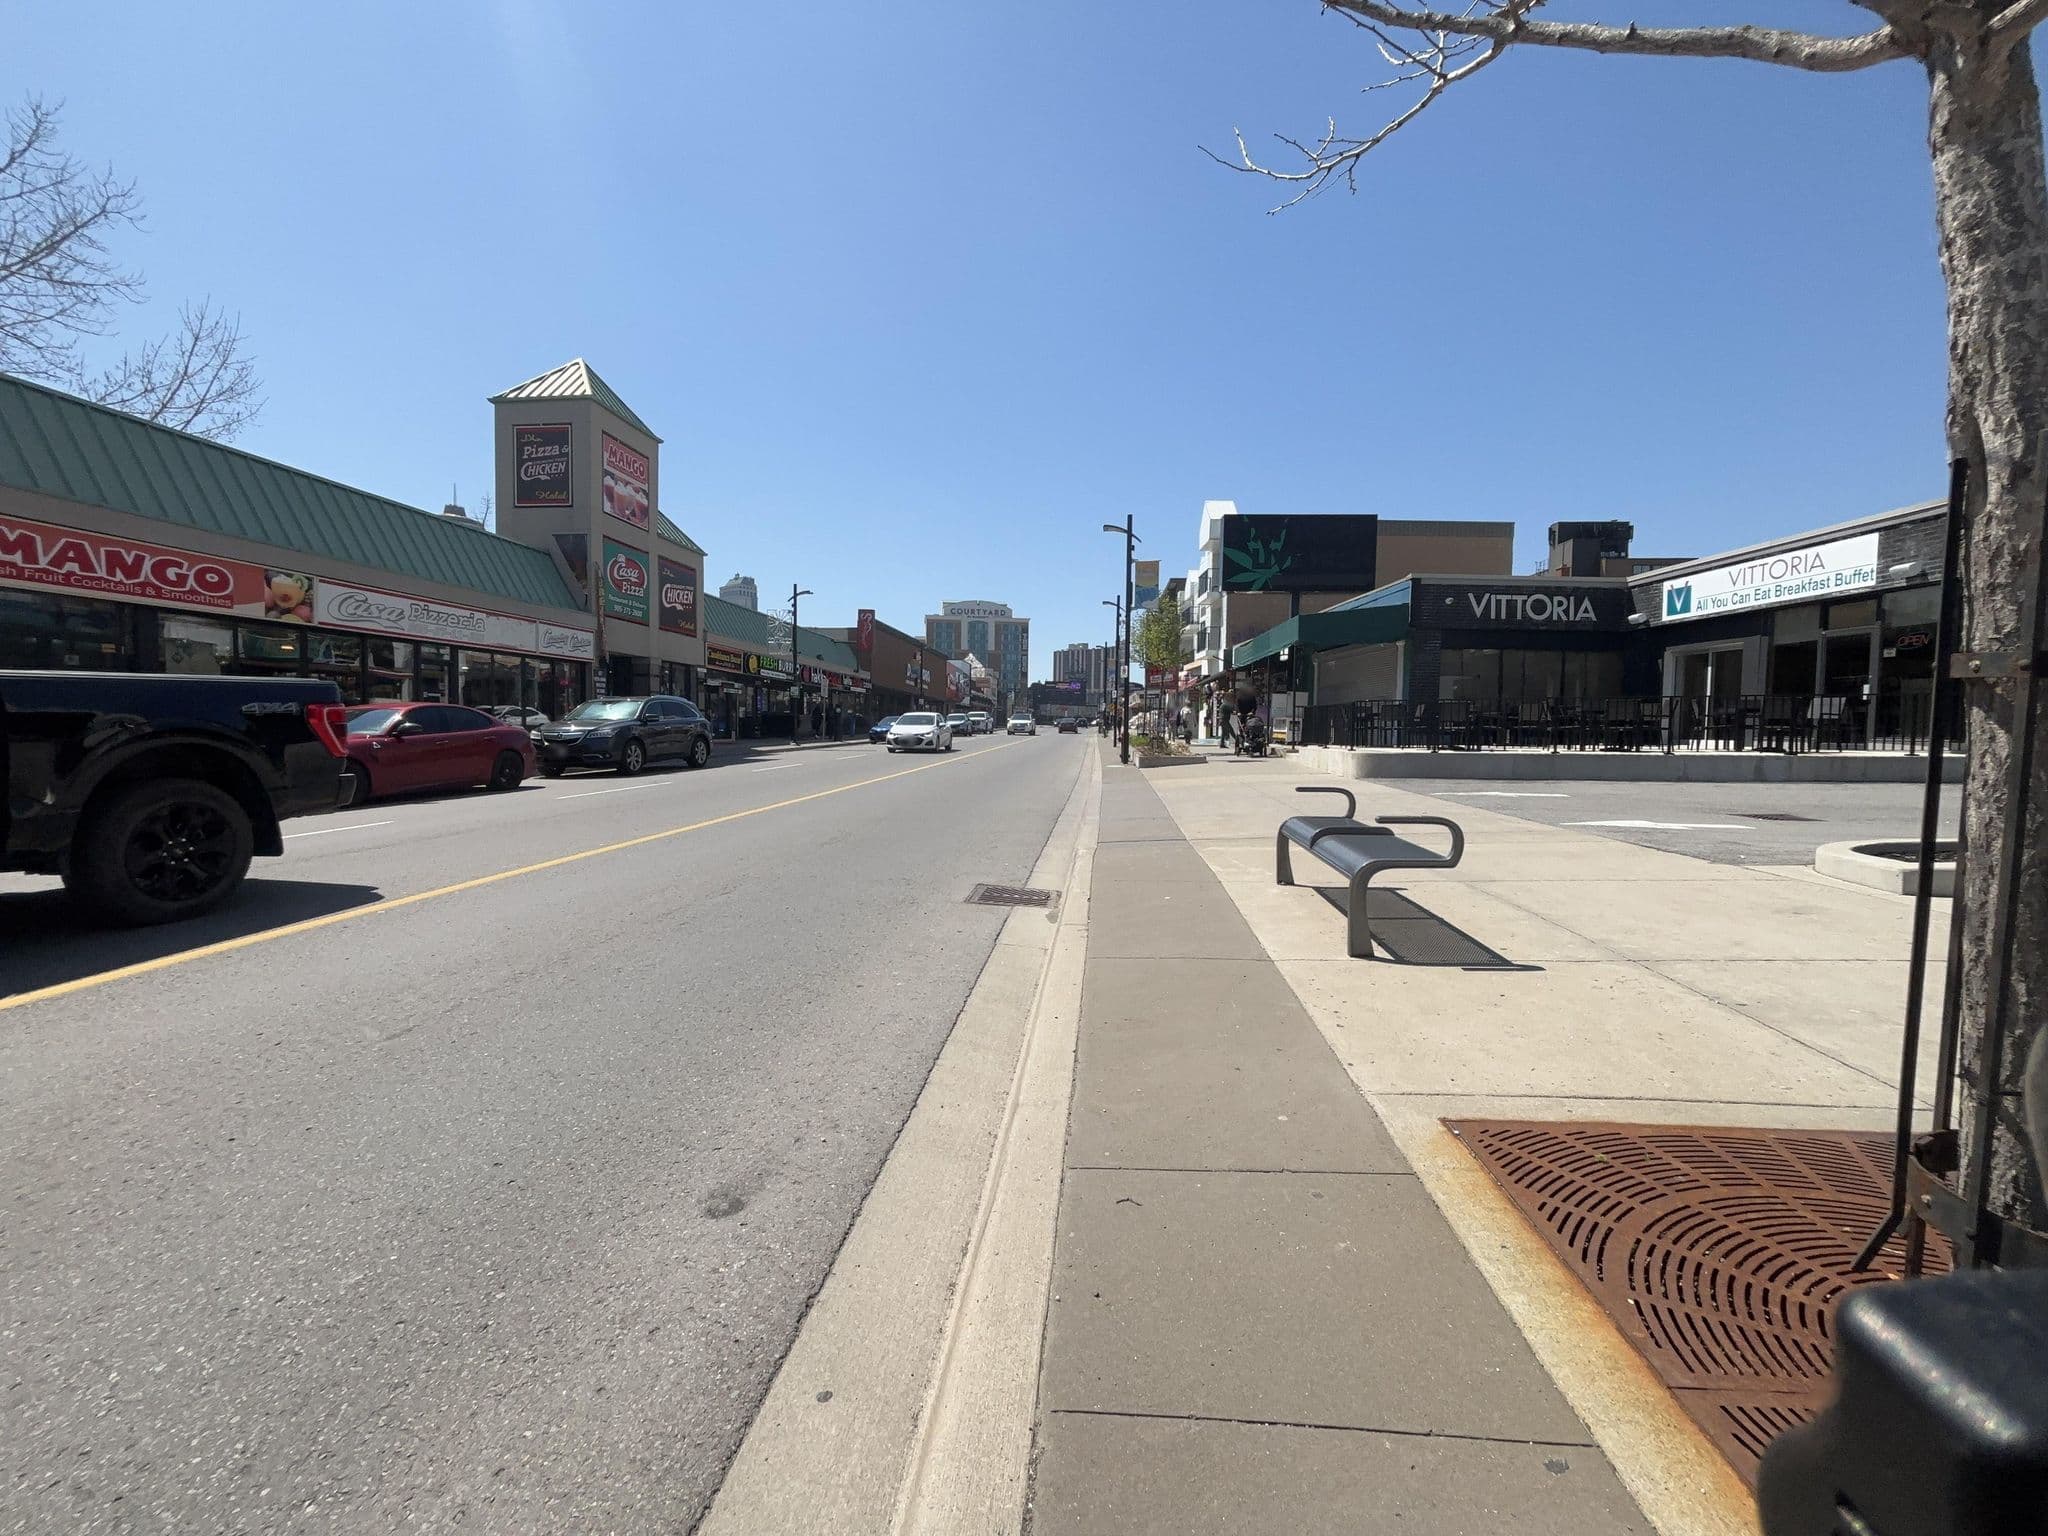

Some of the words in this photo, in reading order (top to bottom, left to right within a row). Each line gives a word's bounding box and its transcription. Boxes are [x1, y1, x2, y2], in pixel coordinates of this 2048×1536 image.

[522, 444, 560, 459] Pizza
[561, 444, 569, 453] &
[607, 443, 646, 479] MANGO
[520, 461, 567, 481] CHICKEN
[0, 526, 234, 596] MANGO
[613, 562, 640, 582] Casa
[1727, 551, 1826, 587] VITTORIA
[24, 569, 66, 585] Fruit
[70, 575, 142, 595] Cocktails
[146, 586, 156, 596] &
[161, 588, 233, 607] Smoothies
[622, 581, 644, 597] Pizza
[662, 583, 694, 611] CHICKEN
[1696, 598, 1709, 612] All
[1711, 595, 1729, 610] You
[1731, 592, 1751, 606] Can
[1754, 588, 1771, 602] Eat
[1774, 577, 1832, 599] Breakfast
[1834, 567, 1875, 588] Buffet
[327, 591, 405, 631] Casa
[408, 603, 487, 633] Pizzeria
[950, 607, 1006, 617] COURTYARD
[1467, 592, 1598, 622] VITTORIA
[1897, 632, 1929, 647] OPEN
[760, 655, 778, 670] FRESH
